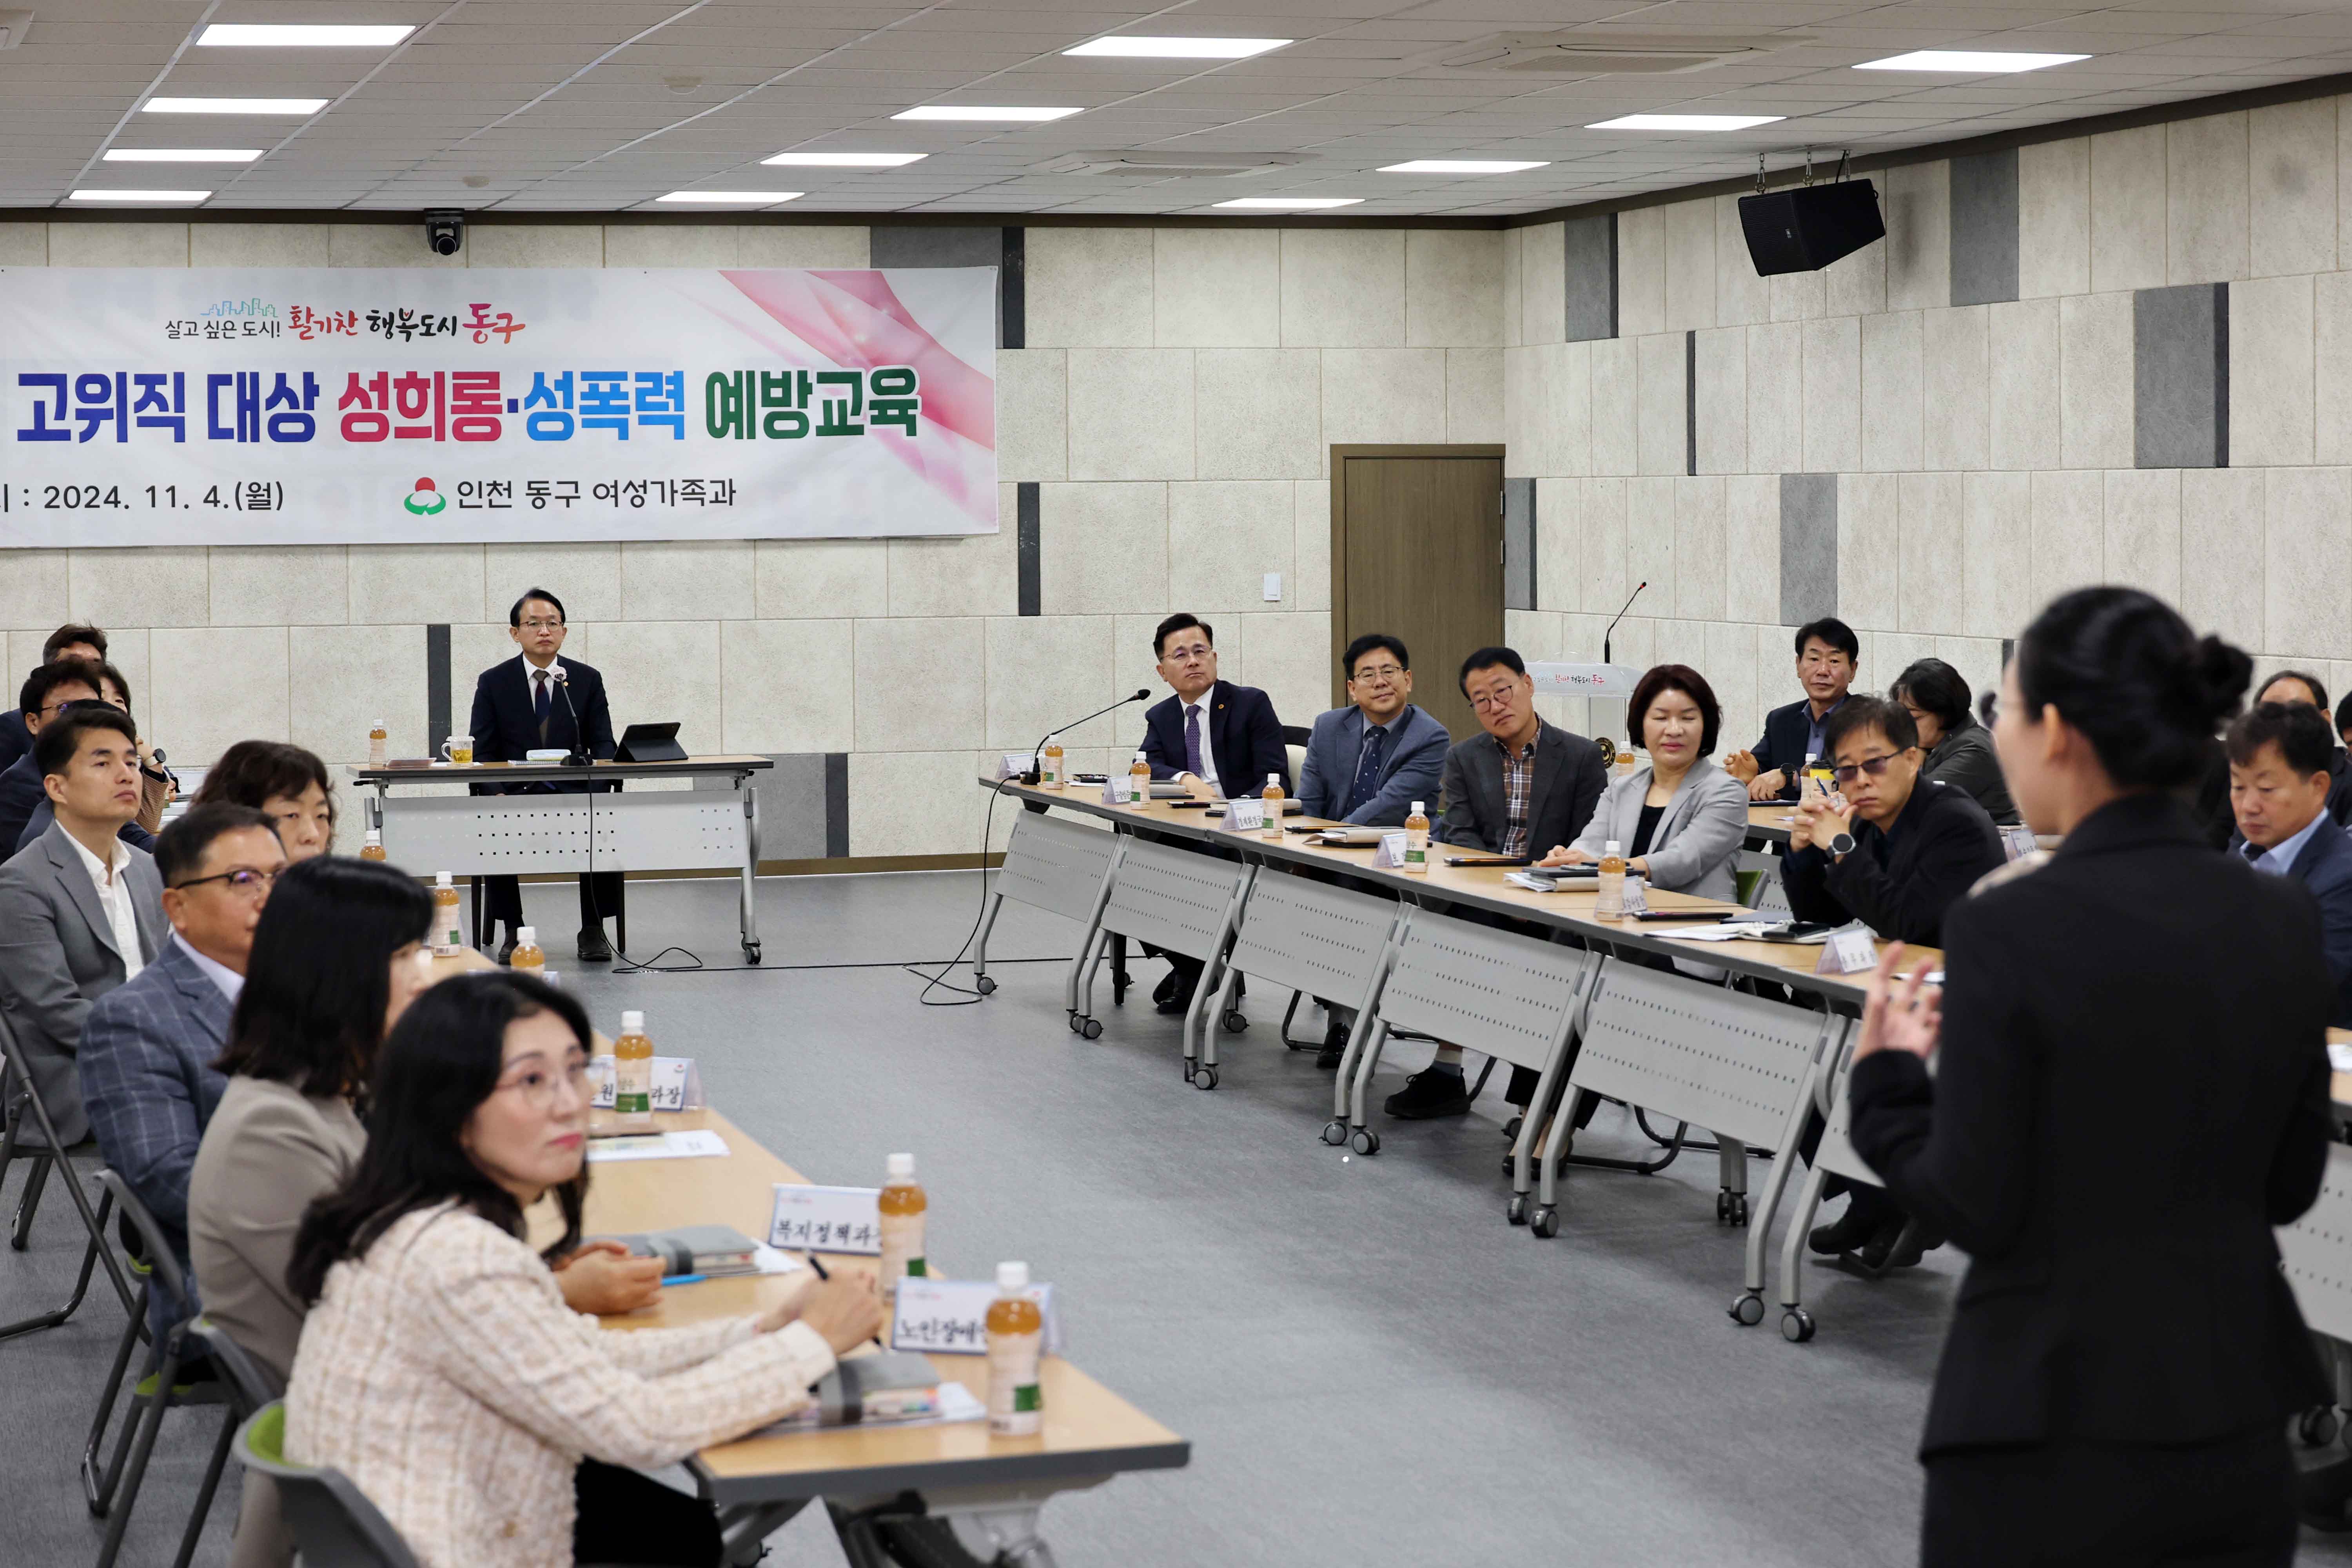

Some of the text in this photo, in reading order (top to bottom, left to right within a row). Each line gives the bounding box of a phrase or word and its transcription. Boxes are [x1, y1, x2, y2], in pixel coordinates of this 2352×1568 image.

[165, 303, 526, 344] 살고 싶은 도시! 활기찬 행복도시 동구
[17, 371, 185, 443] 고위직
[207, 371, 319, 443] 대상
[706, 370, 918, 440] 예방교육
[44, 485, 129, 510] 2024.
[145, 485, 189, 509] 11.
[203, 481, 283, 511] 4.(월)
[457, 479, 737, 510] 인천 동구 여성가족과
[1591, 674, 1605, 686] 동구
[1238, 815, 1262, 827] 경제환경국
